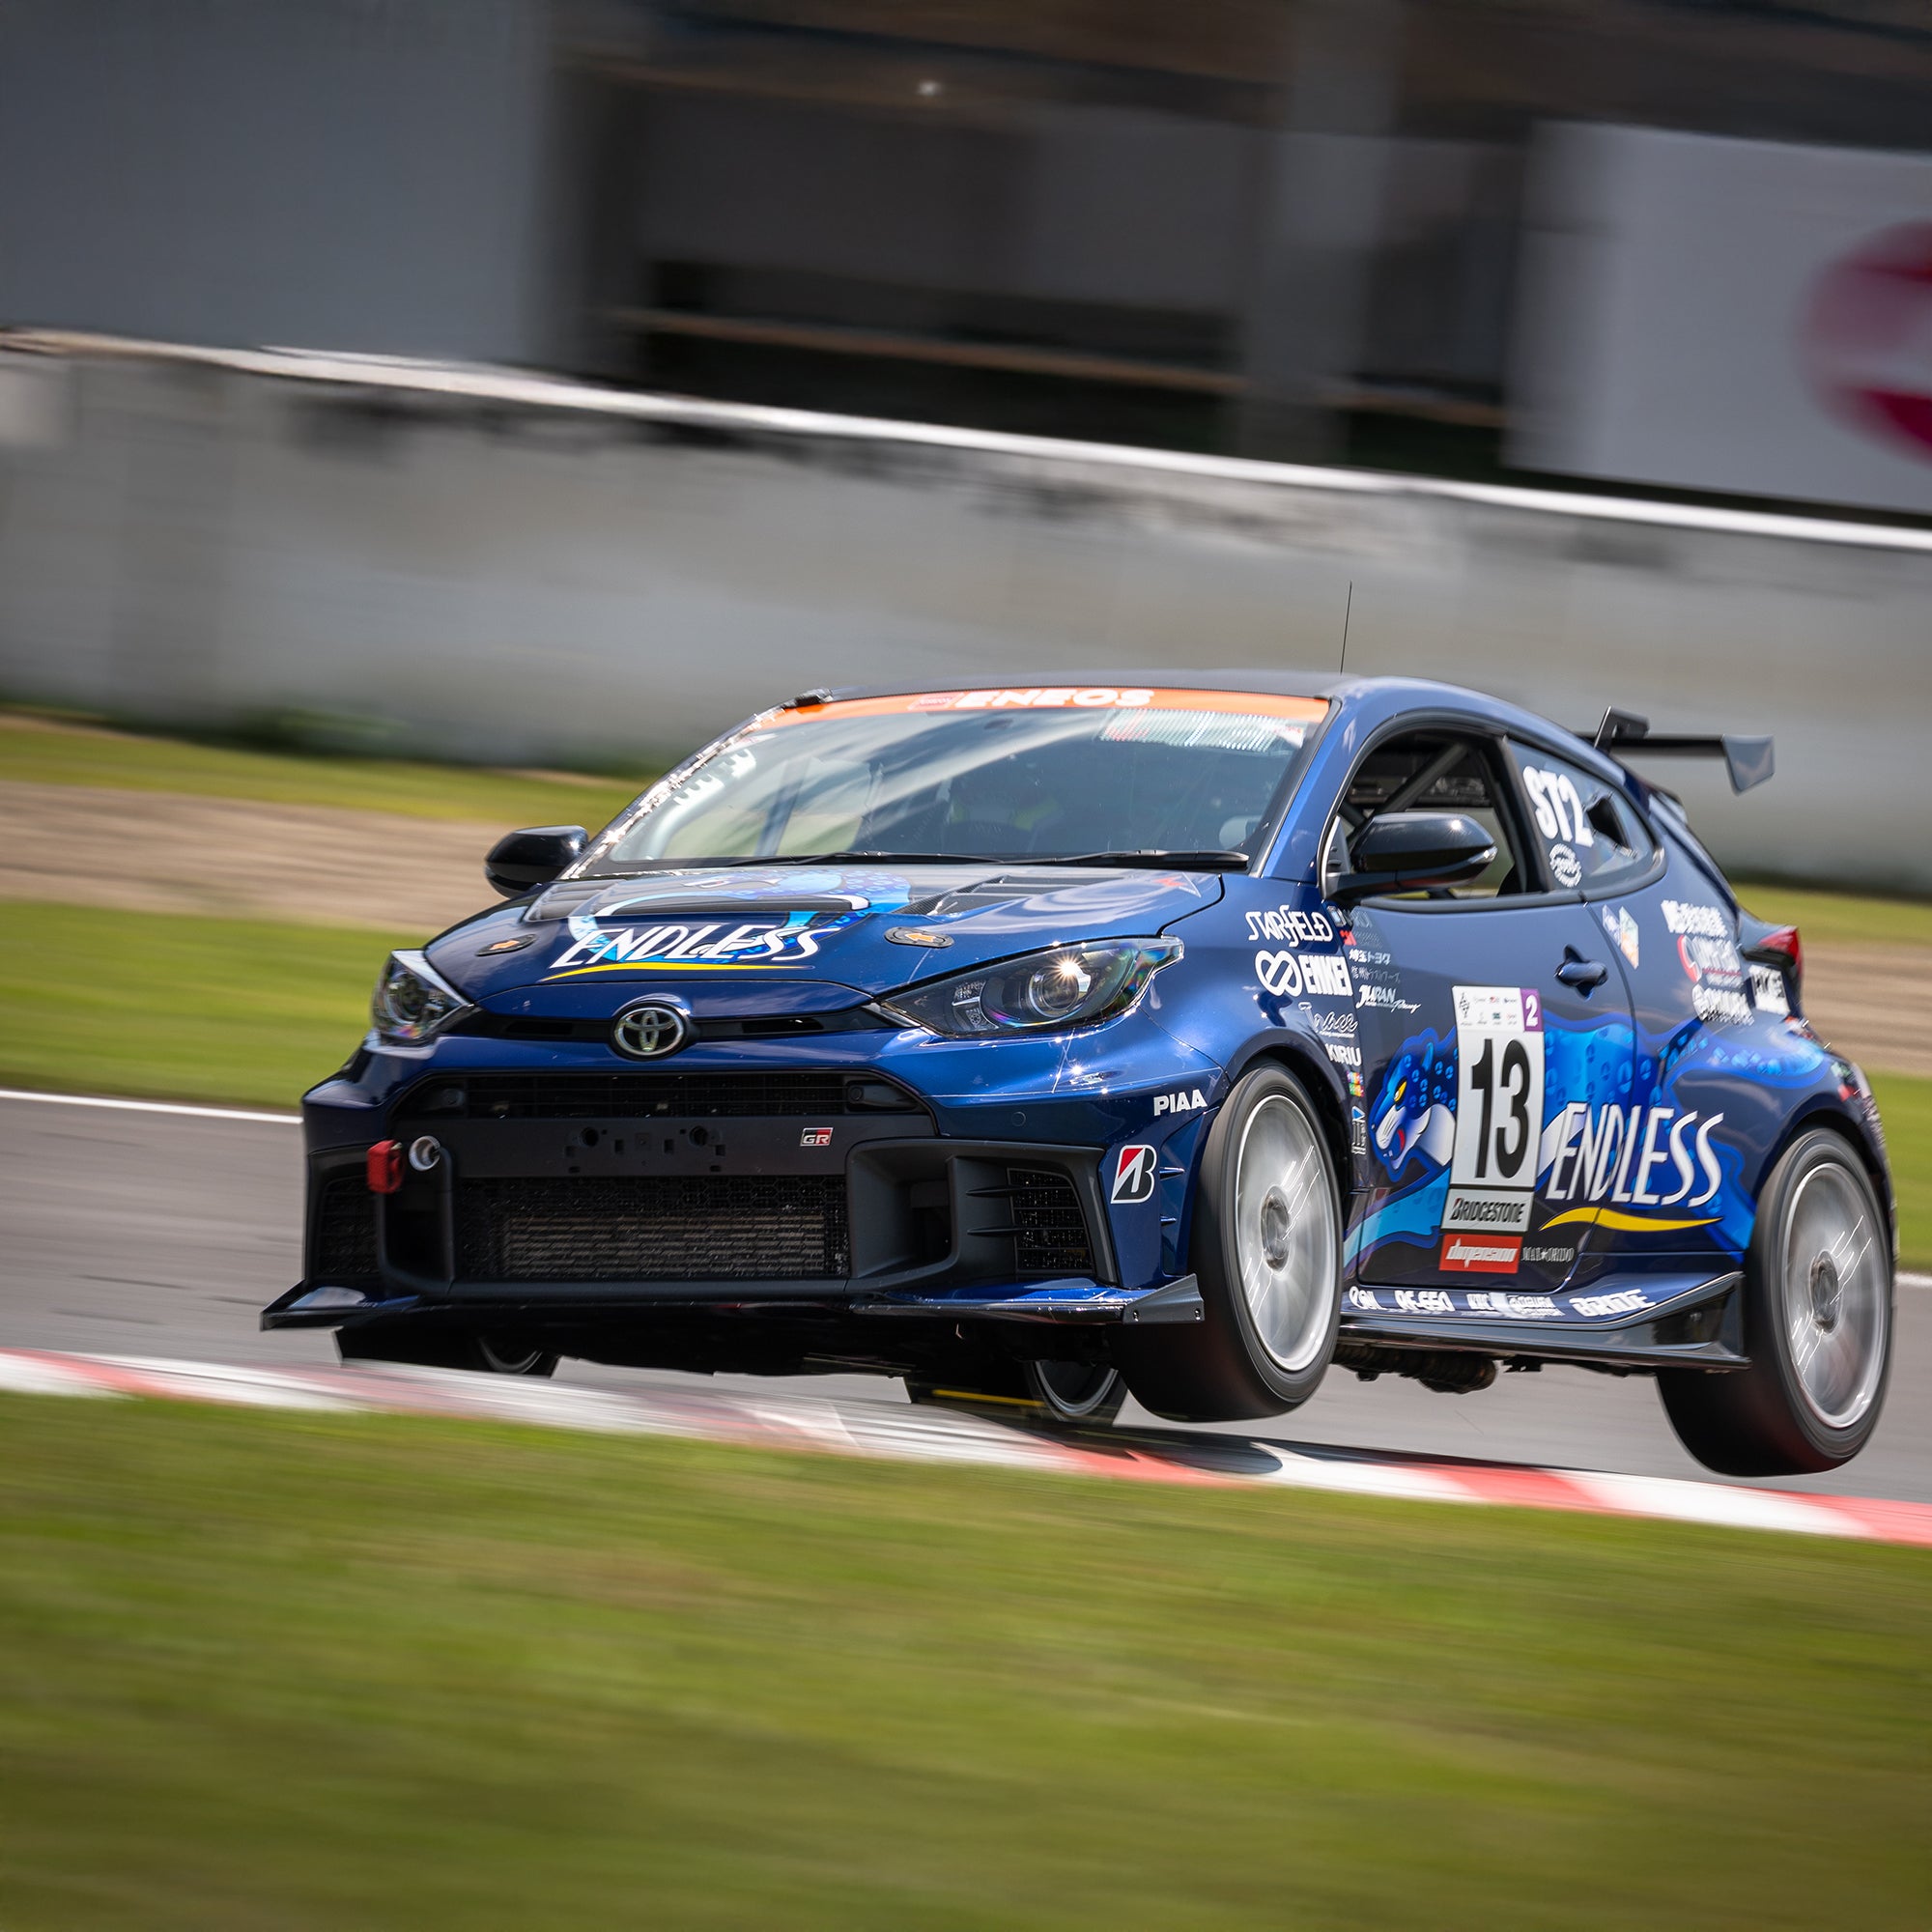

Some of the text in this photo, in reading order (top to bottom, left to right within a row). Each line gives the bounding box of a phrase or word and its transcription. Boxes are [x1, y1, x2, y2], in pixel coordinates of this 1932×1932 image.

[954, 688, 1154, 708] ENEOS
[1523, 766, 1594, 847] ST2
[550, 922, 841, 969] ENDLESS
[1525, 995, 1539, 1027] 2
[1325, 1043, 1362, 1066] KIRIU
[1153, 1089, 1208, 1117] PIAA
[1470, 1038, 1531, 1179] 13
[802, 1134, 831, 1145] GR
[1546, 1101, 1724, 1208] ENDLESS
[1450, 1198, 1526, 1223] BRIDGESTONE
